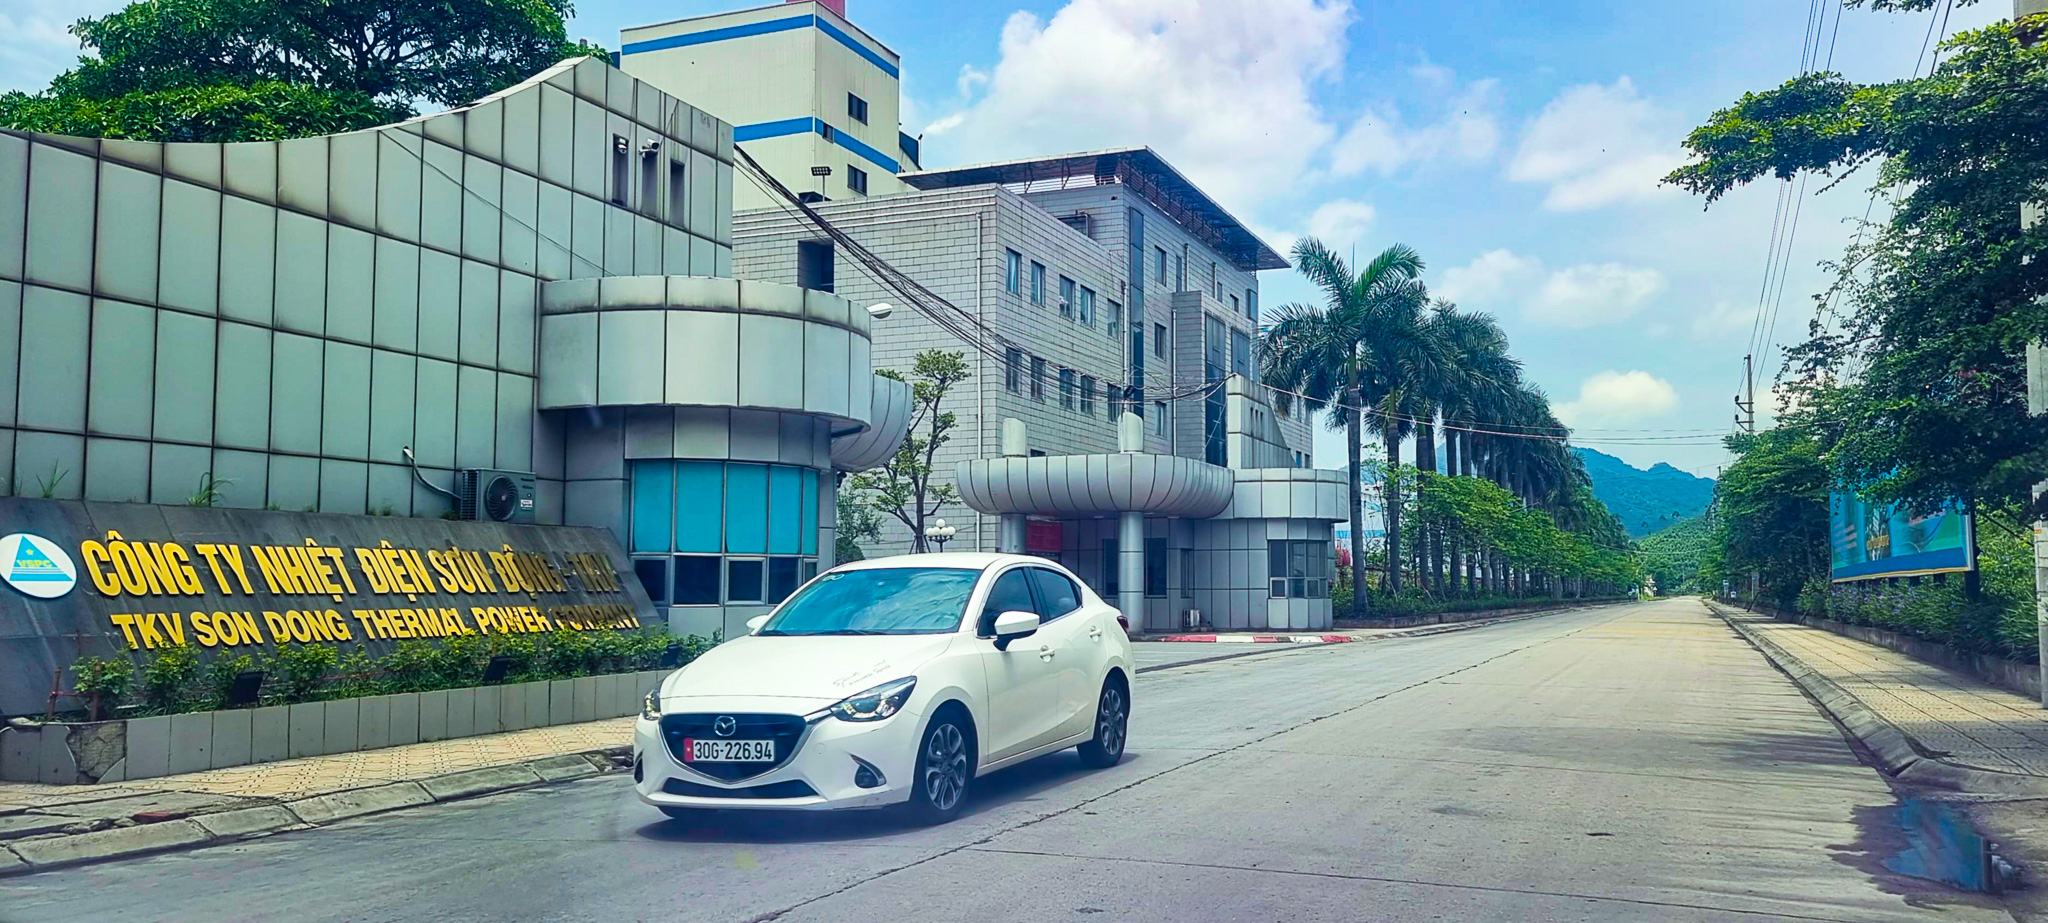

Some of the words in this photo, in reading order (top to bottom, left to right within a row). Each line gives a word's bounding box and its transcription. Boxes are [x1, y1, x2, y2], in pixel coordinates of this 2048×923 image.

[81, 530, 205, 596] CÔNG
[194, 544, 254, 595] TY
[250, 537, 357, 602] NHIỆT
[354, 540, 437, 602] ĐIỆN
[428, 546, 498, 594] SƠN
[488, 543, 567, 600] ĐỘNG
[110, 612, 186, 649] TKV
[190, 611, 264, 647] SON
[262, 609, 353, 643] DONG
[351, 608, 475, 639] THERMAL
[471, 606, 553, 636] POWER
[694, 742, 773, 760] 30G-226.94
